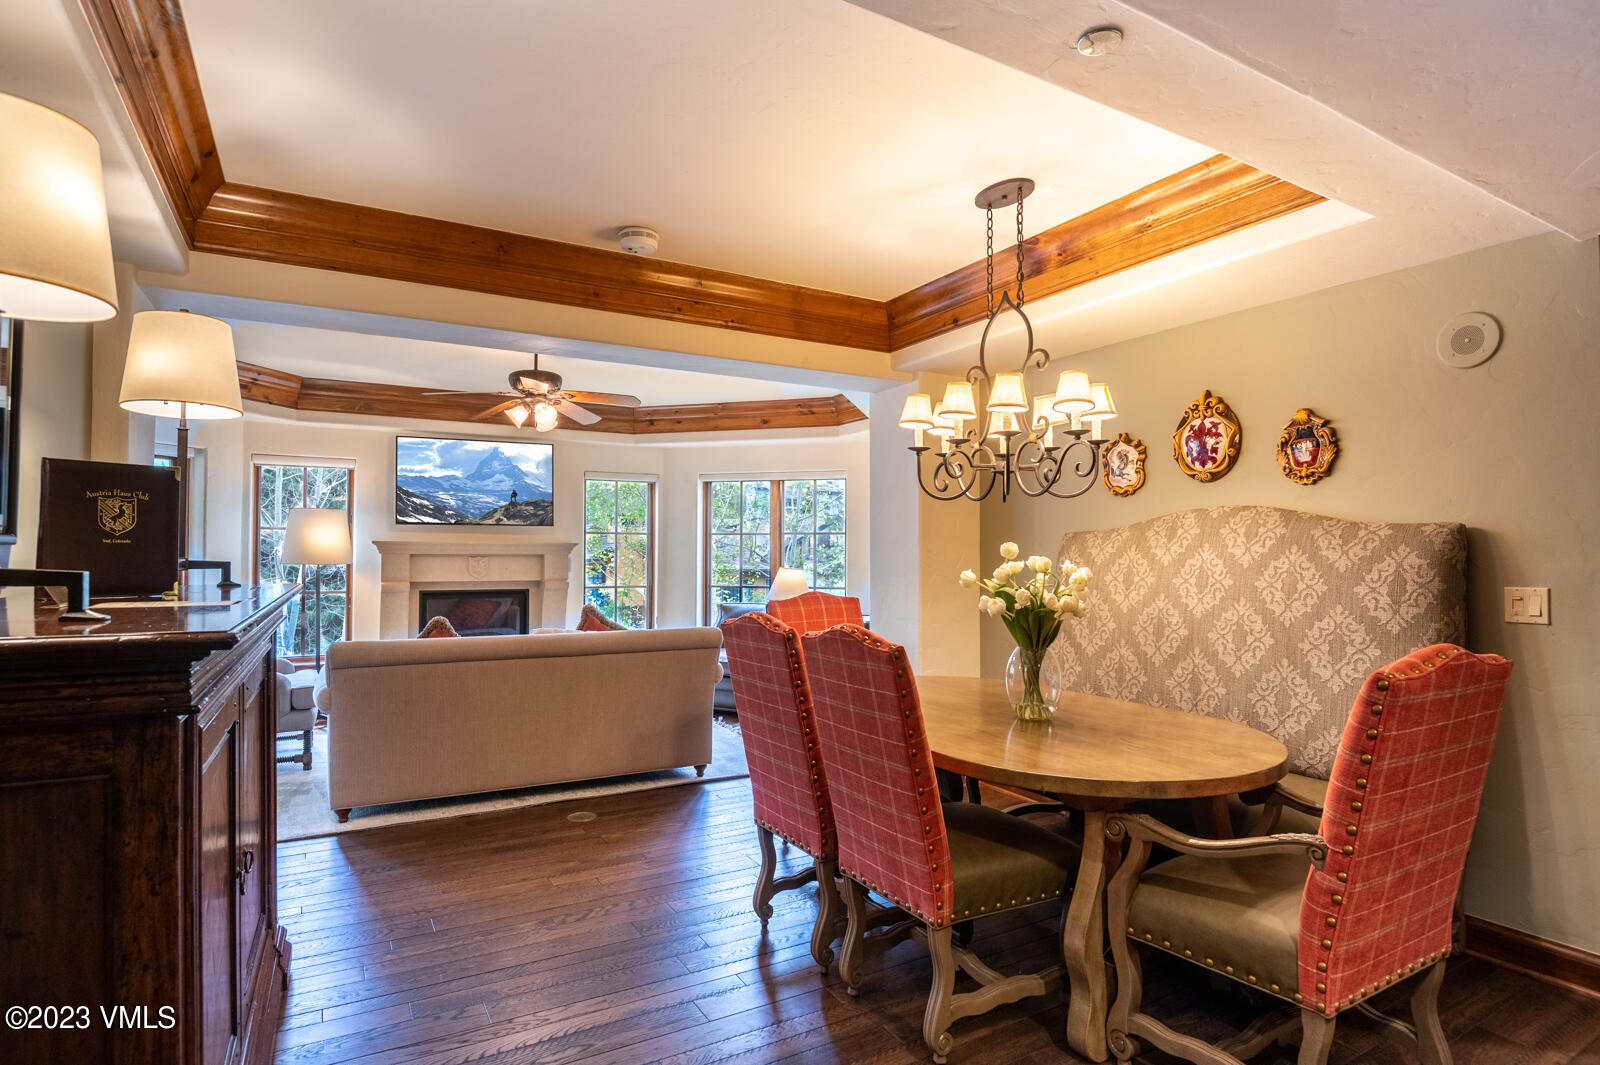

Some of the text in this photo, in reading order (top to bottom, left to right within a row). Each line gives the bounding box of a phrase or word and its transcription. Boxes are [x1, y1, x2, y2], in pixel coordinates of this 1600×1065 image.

[86, 489, 149, 501] Austria Haus Club
